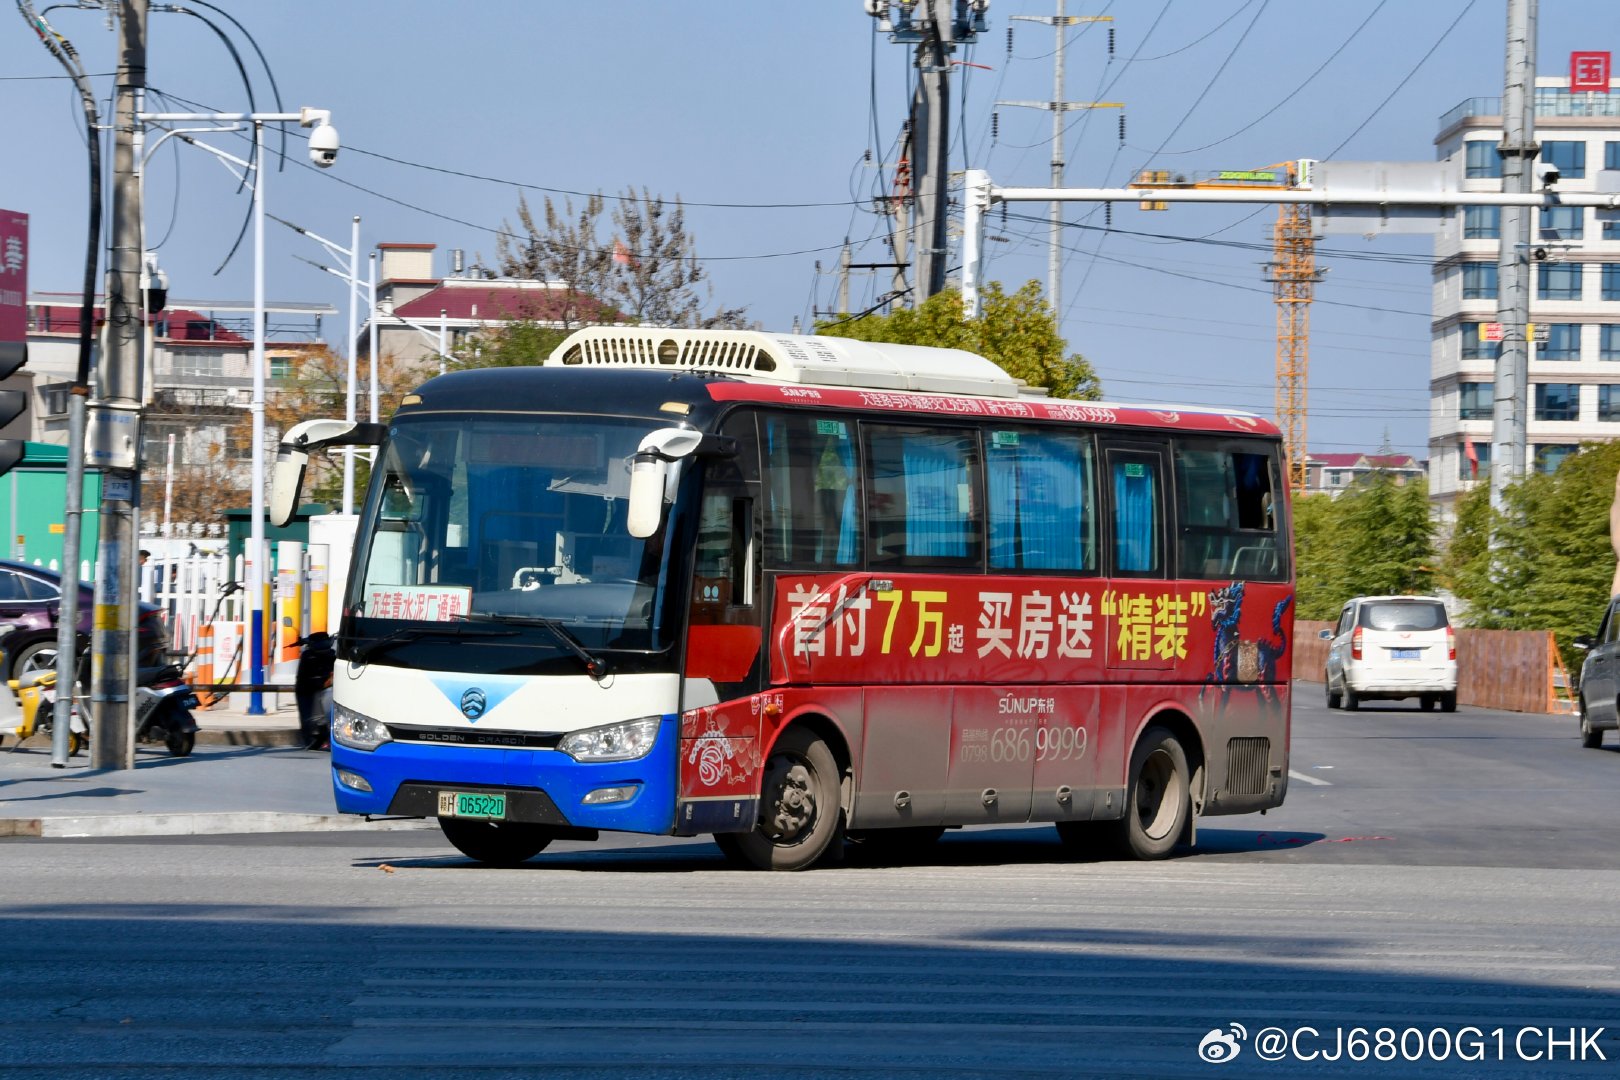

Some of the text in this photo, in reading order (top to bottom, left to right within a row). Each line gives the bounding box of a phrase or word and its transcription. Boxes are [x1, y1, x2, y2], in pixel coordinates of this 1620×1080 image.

[370, 591, 461, 622] 万年青水泥厂通勤
[418, 733, 527, 746] GOLDEN DRAGON
[990, 727, 1030, 762] 686
[1036, 726, 1087, 762] 9999
